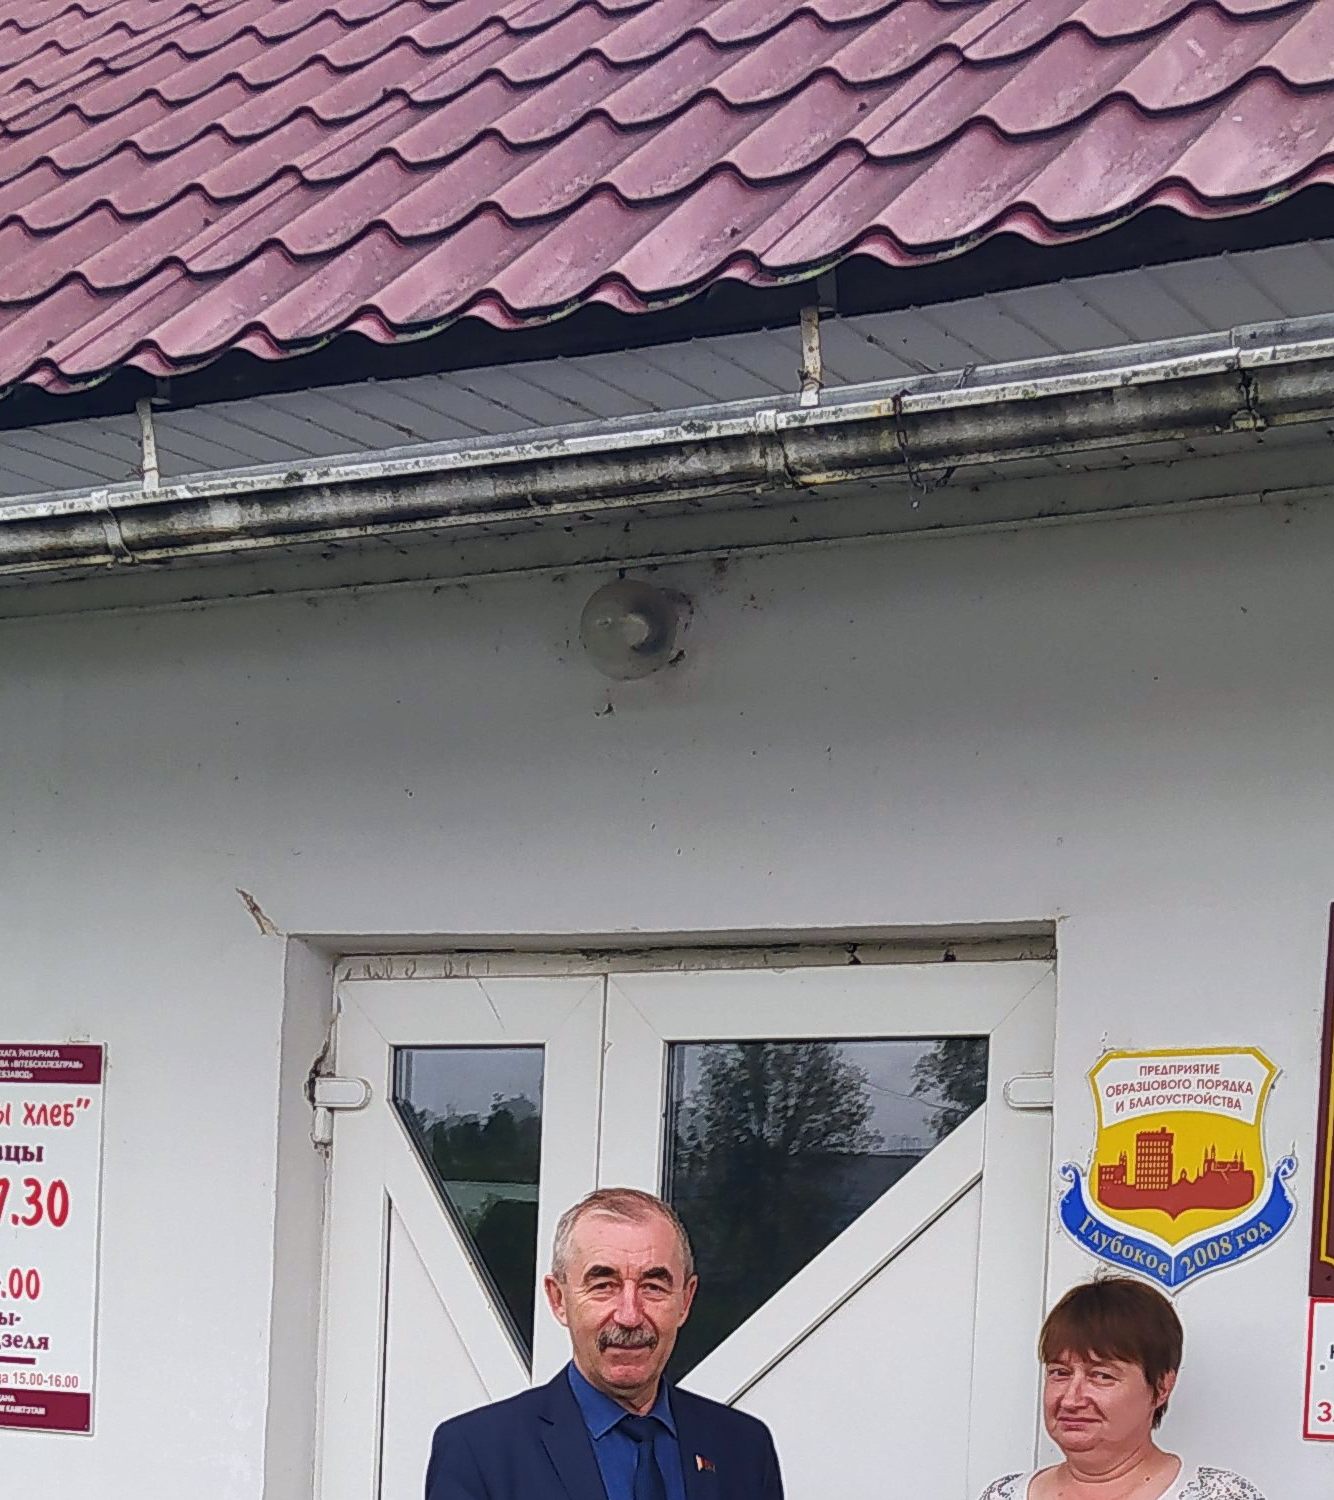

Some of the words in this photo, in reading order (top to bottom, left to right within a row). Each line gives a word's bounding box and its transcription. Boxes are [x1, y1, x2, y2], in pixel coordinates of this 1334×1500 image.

[1139, 1064, 1220, 1076] ПРЕДПРИЯТИЕ
[1105, 1079, 1192, 1098] ОБРАЗЦОВОГО
[1197, 1079, 1253, 1095] ПОРЯДКА
[1116, 1101, 1124, 1113] И
[1129, 1093, 1242, 1111] БЛАГОУСТРОЙСТВА
[1078, 1216, 1170, 1277] Глубокое
[1180, 1235, 1234, 1277] 2008
[1236, 1221, 1273, 1245] год
[13, 1373, 79, 1388] 15.00-16.00
